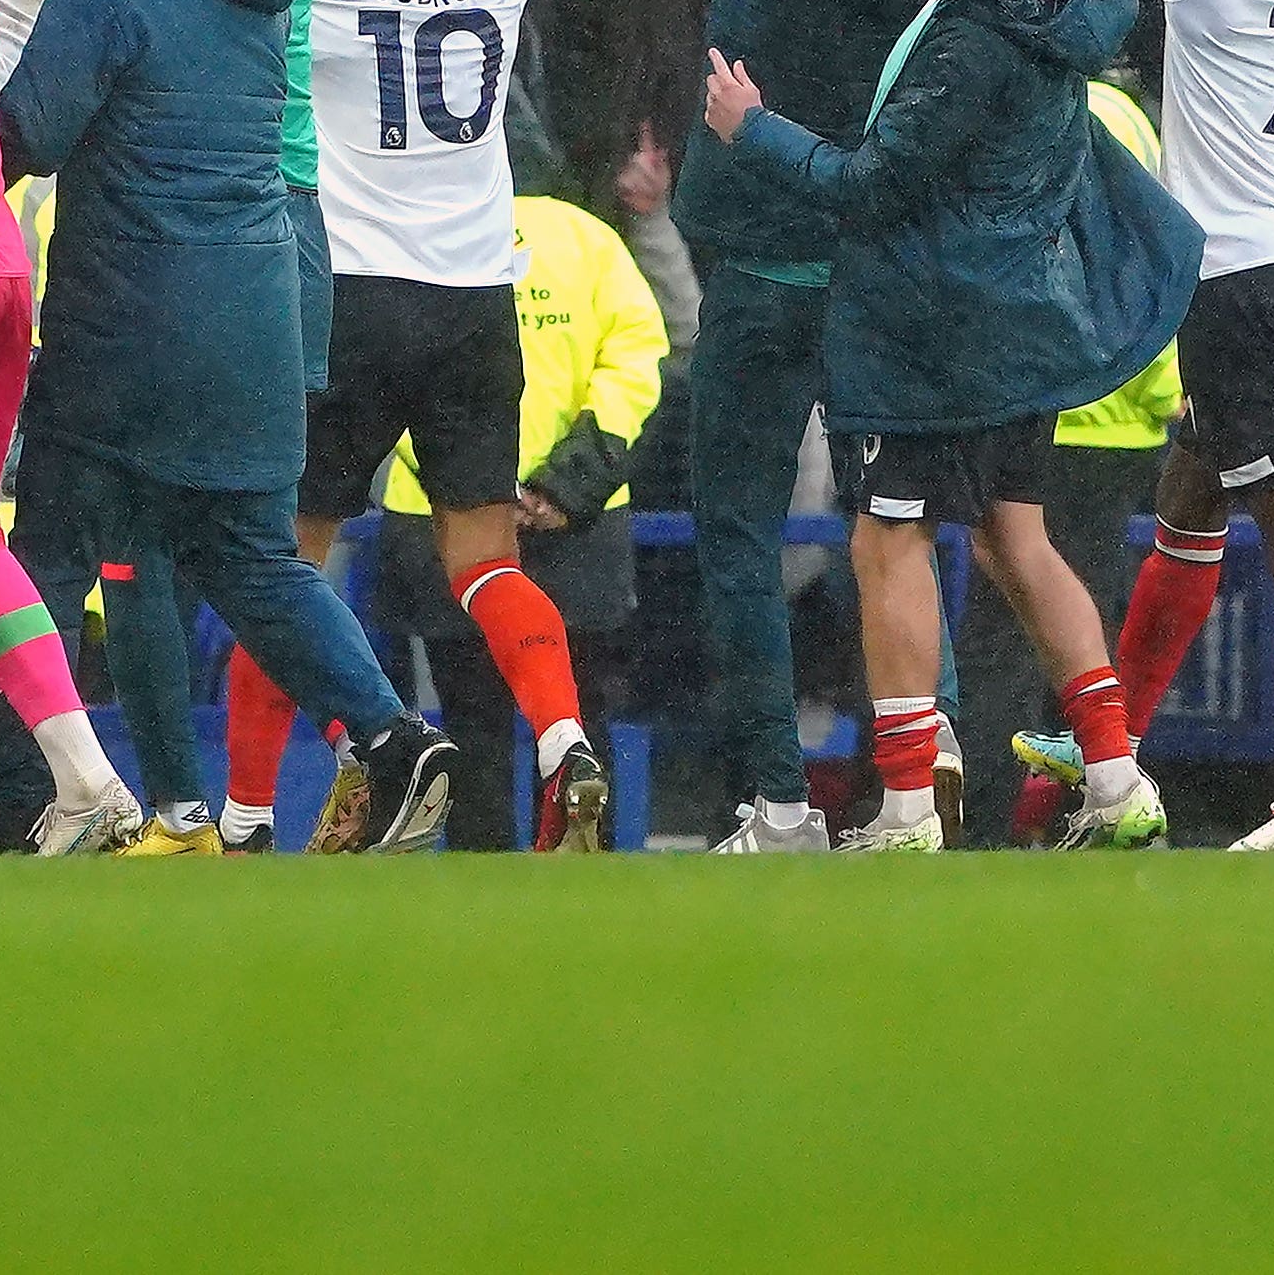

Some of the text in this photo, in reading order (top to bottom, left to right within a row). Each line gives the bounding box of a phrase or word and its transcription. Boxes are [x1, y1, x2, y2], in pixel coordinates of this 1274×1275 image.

[358, 8, 505, 150] 10
[531, 287, 551, 301] to
[535, 313, 571, 330] you
